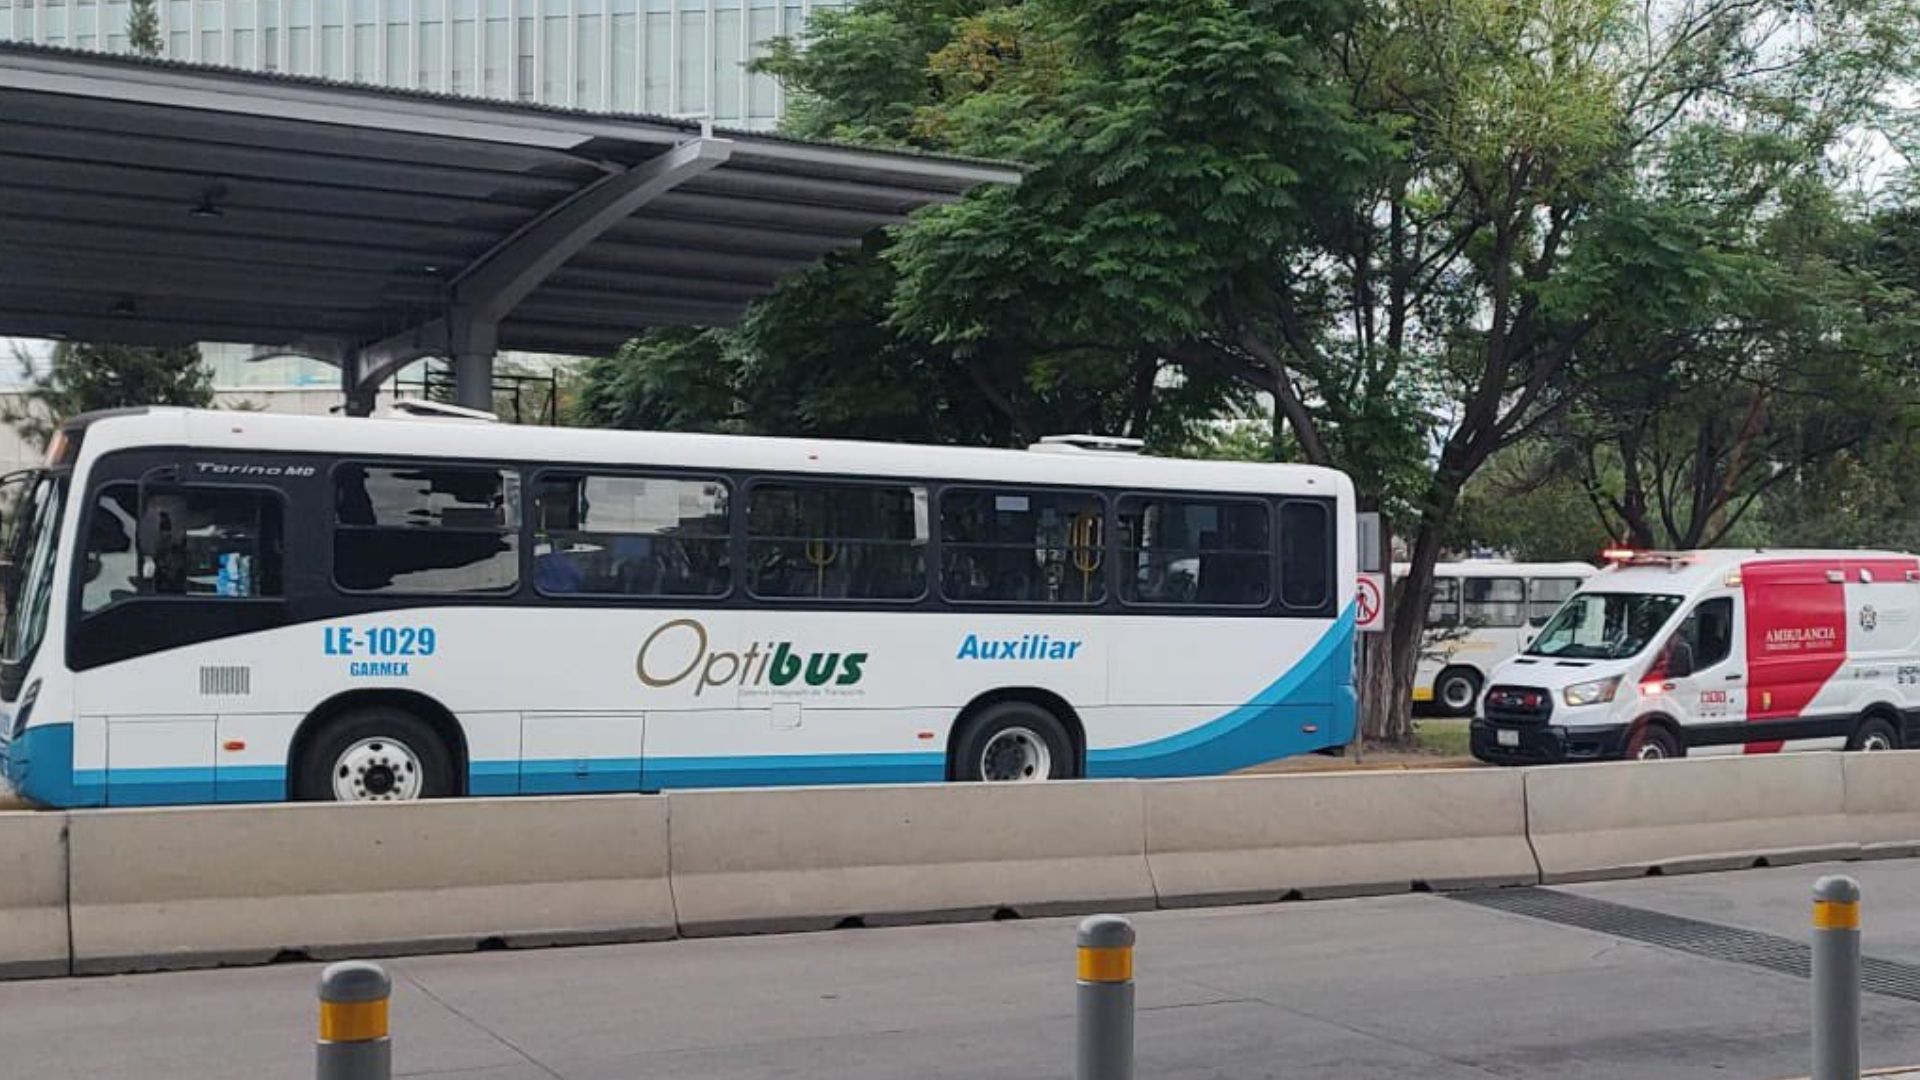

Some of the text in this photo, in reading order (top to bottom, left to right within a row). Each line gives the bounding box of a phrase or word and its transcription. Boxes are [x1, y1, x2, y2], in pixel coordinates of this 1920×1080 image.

[196, 462, 280, 475] Torino
[324, 627, 435, 656] LE-1029
[1765, 627, 1836, 643] AMBULANCIA
[635, 618, 868, 697] Optibus
[957, 634, 1082, 660] Auxiliar
[349, 661, 410, 677] GARMEX
